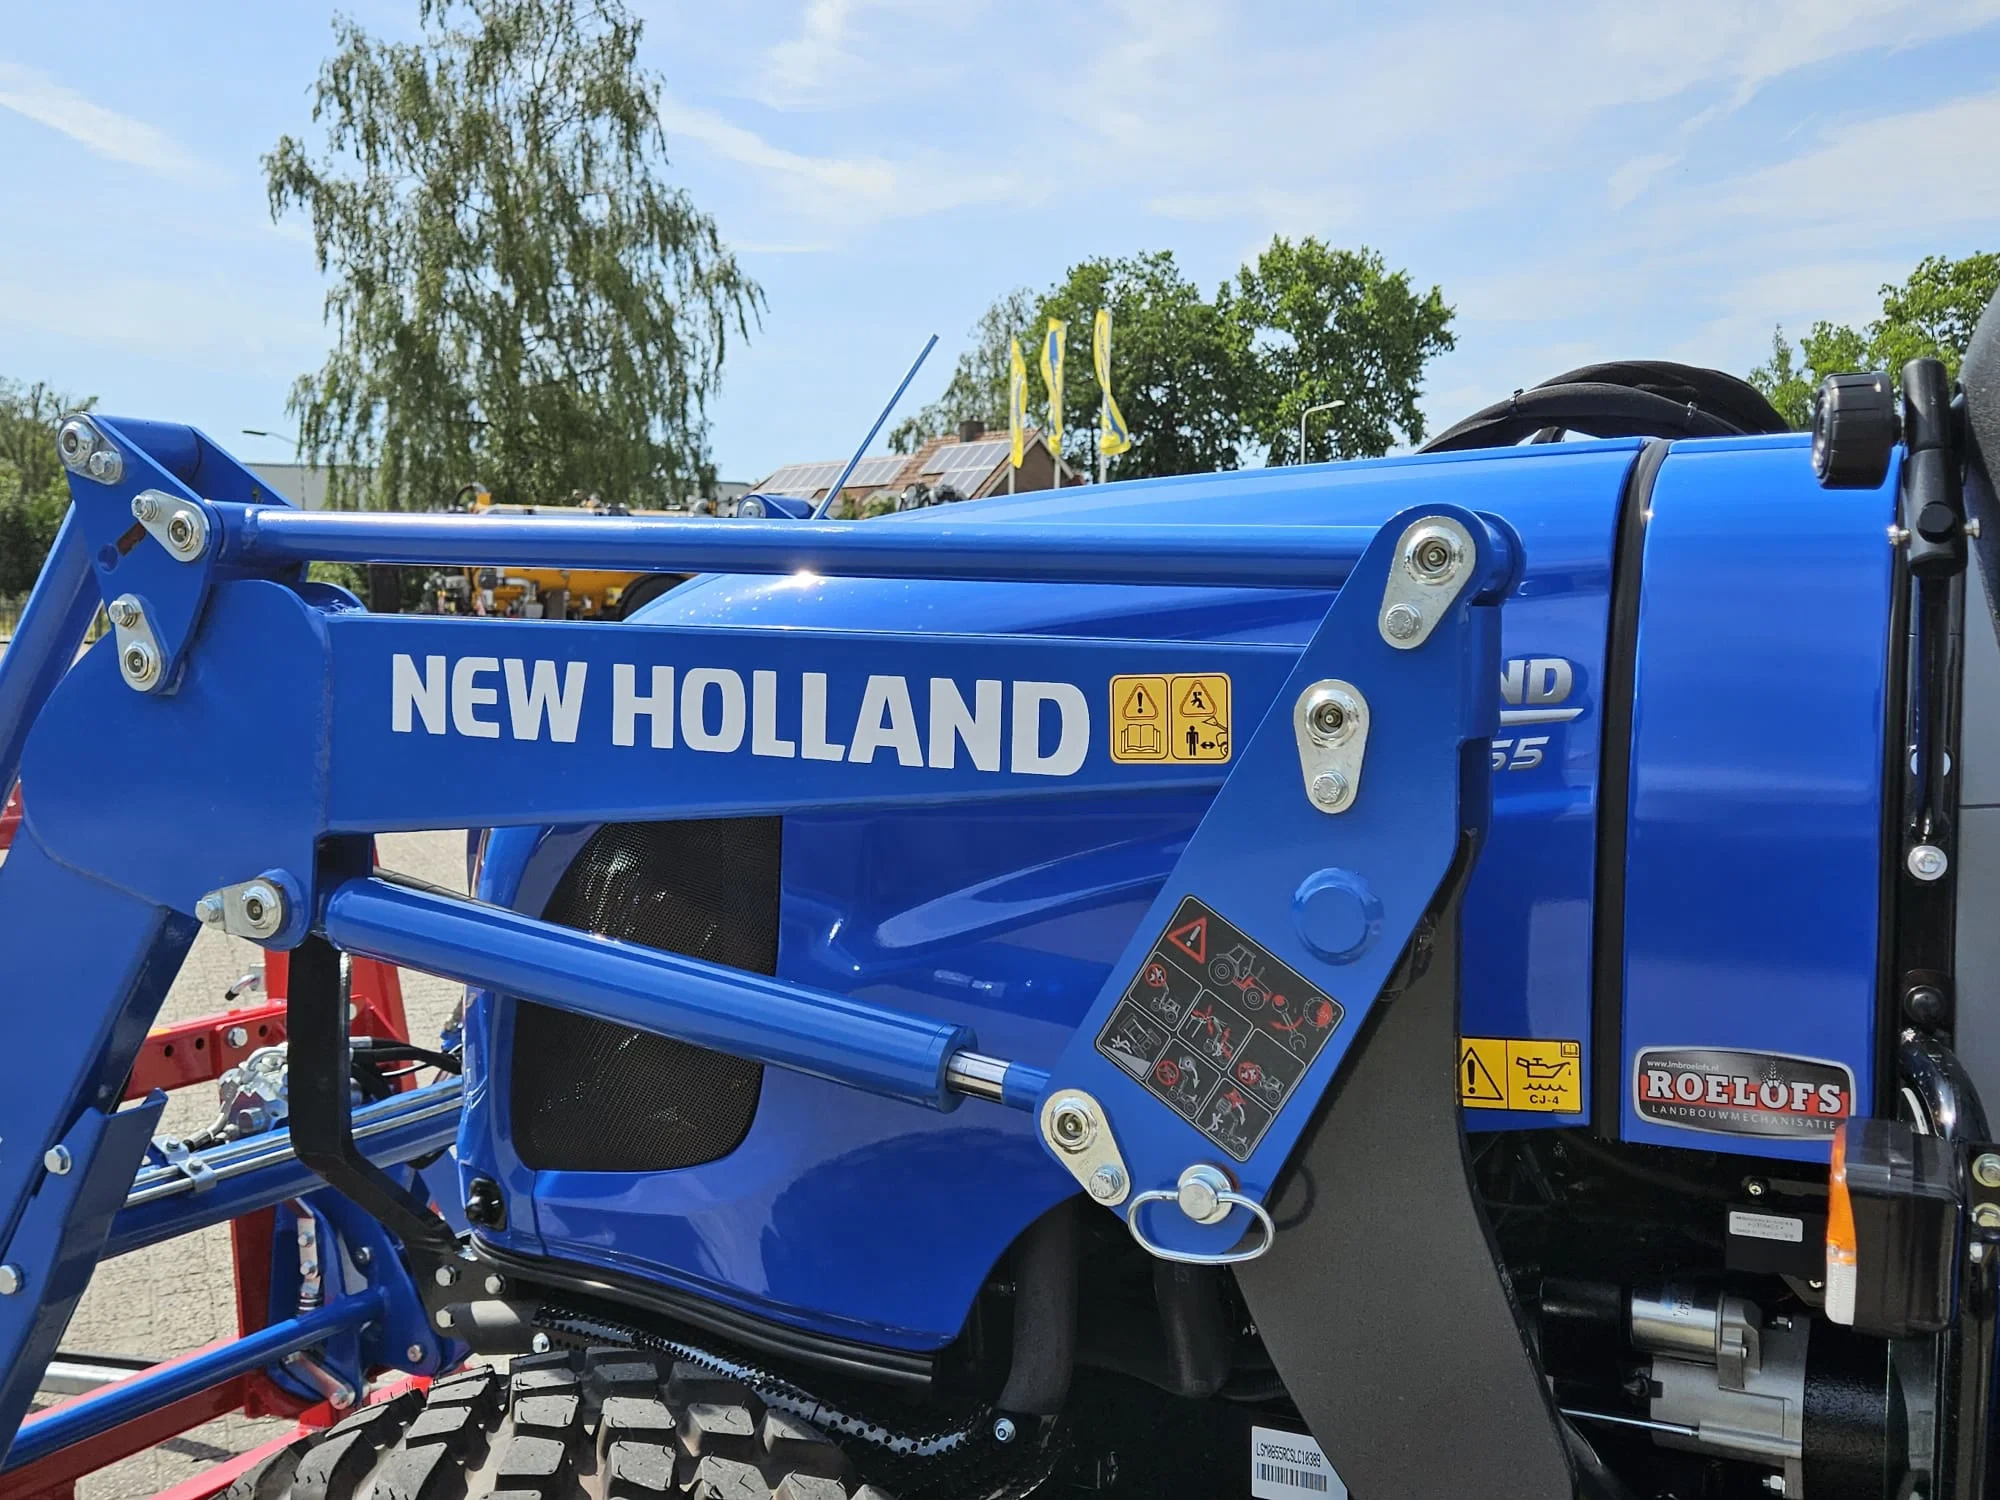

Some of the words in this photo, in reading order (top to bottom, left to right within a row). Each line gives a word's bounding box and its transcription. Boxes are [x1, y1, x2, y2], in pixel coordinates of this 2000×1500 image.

[391, 653, 587, 743] NEW
[612, 664, 1090, 776] HOLLAND
[1529, 1094, 1559, 1104] CJ-4
[1647, 1070, 1842, 1114] ROELOFS
[1652, 1104, 1836, 1130] LANDBOUWMECHANISATIE
